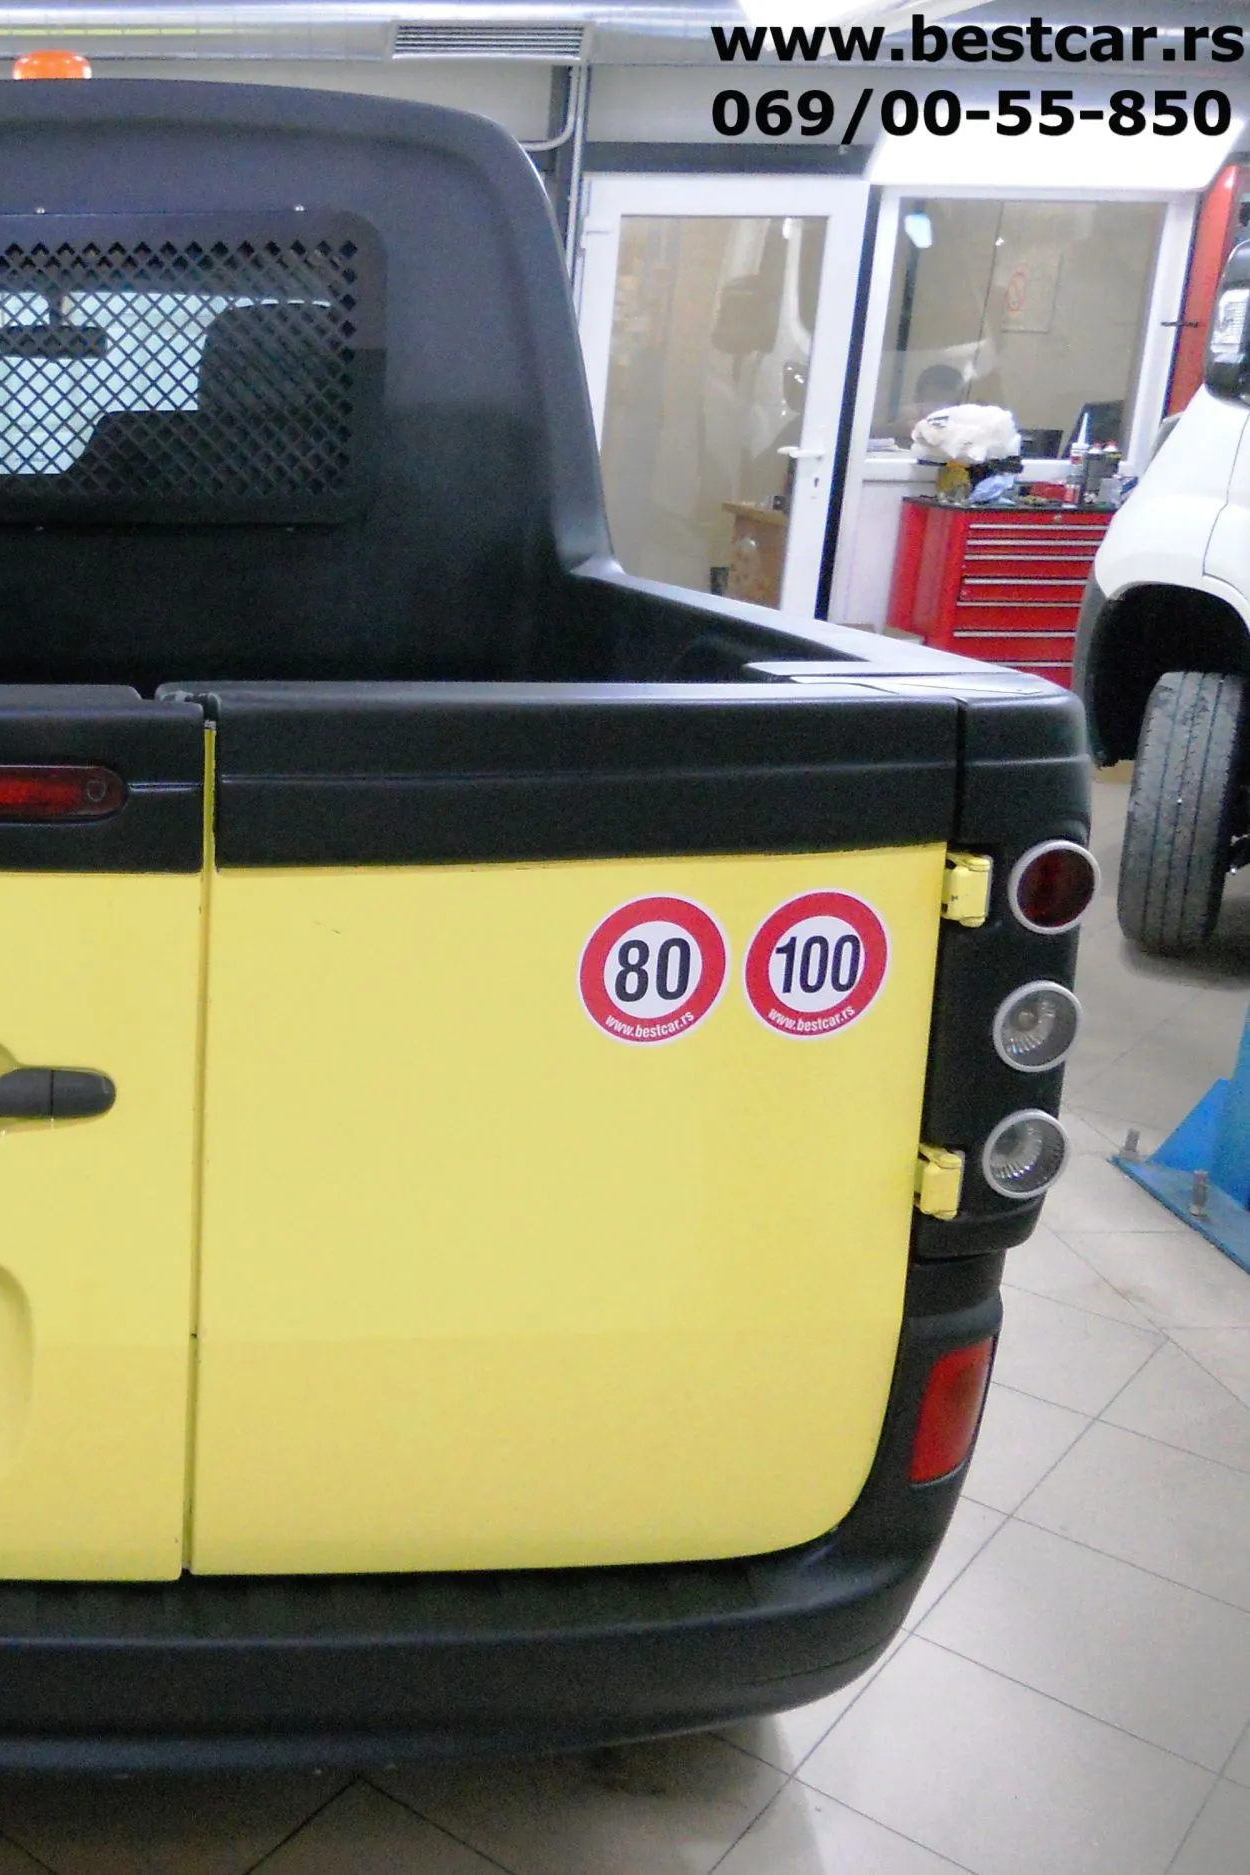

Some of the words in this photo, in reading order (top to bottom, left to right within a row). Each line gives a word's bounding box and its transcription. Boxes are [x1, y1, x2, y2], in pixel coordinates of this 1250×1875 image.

[615, 937, 691, 1002] 80
[775, 934, 861, 994] 100
[605, 1010, 695, 1039] www.bestcar.rs
[768, 1005, 856, 1033] www.bestcar.rs
